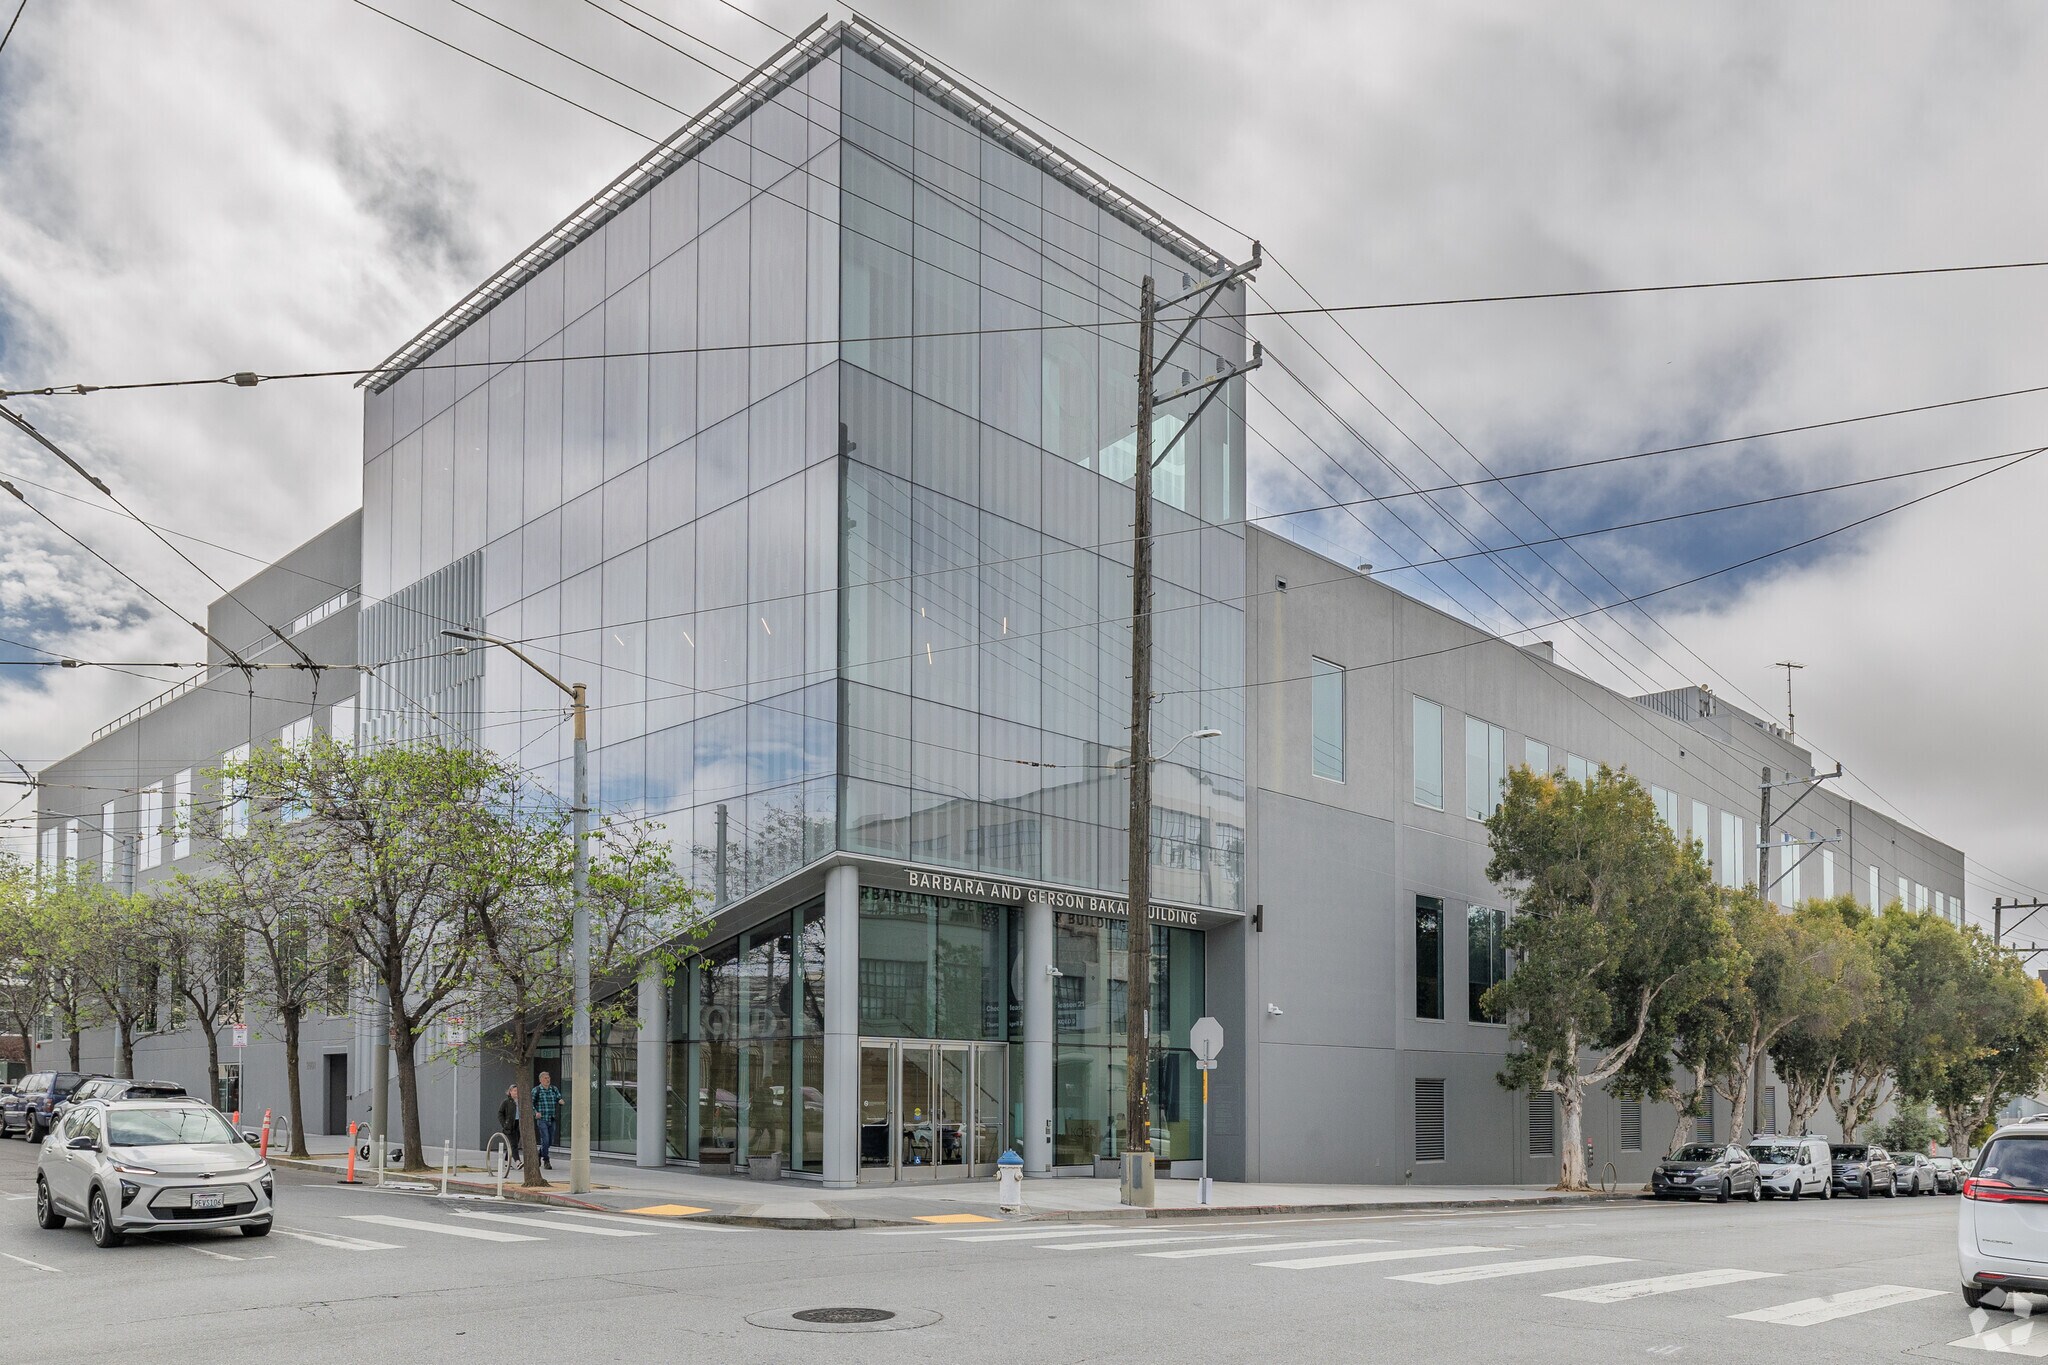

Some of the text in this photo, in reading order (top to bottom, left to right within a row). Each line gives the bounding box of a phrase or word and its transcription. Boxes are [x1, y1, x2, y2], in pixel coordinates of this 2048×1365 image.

[909, 872, 985, 896] BARBARA
[990, 884, 1021, 901] AND
[1027, 889, 1084, 910] GERSON
[1148, 905, 1197, 925] UILDING
